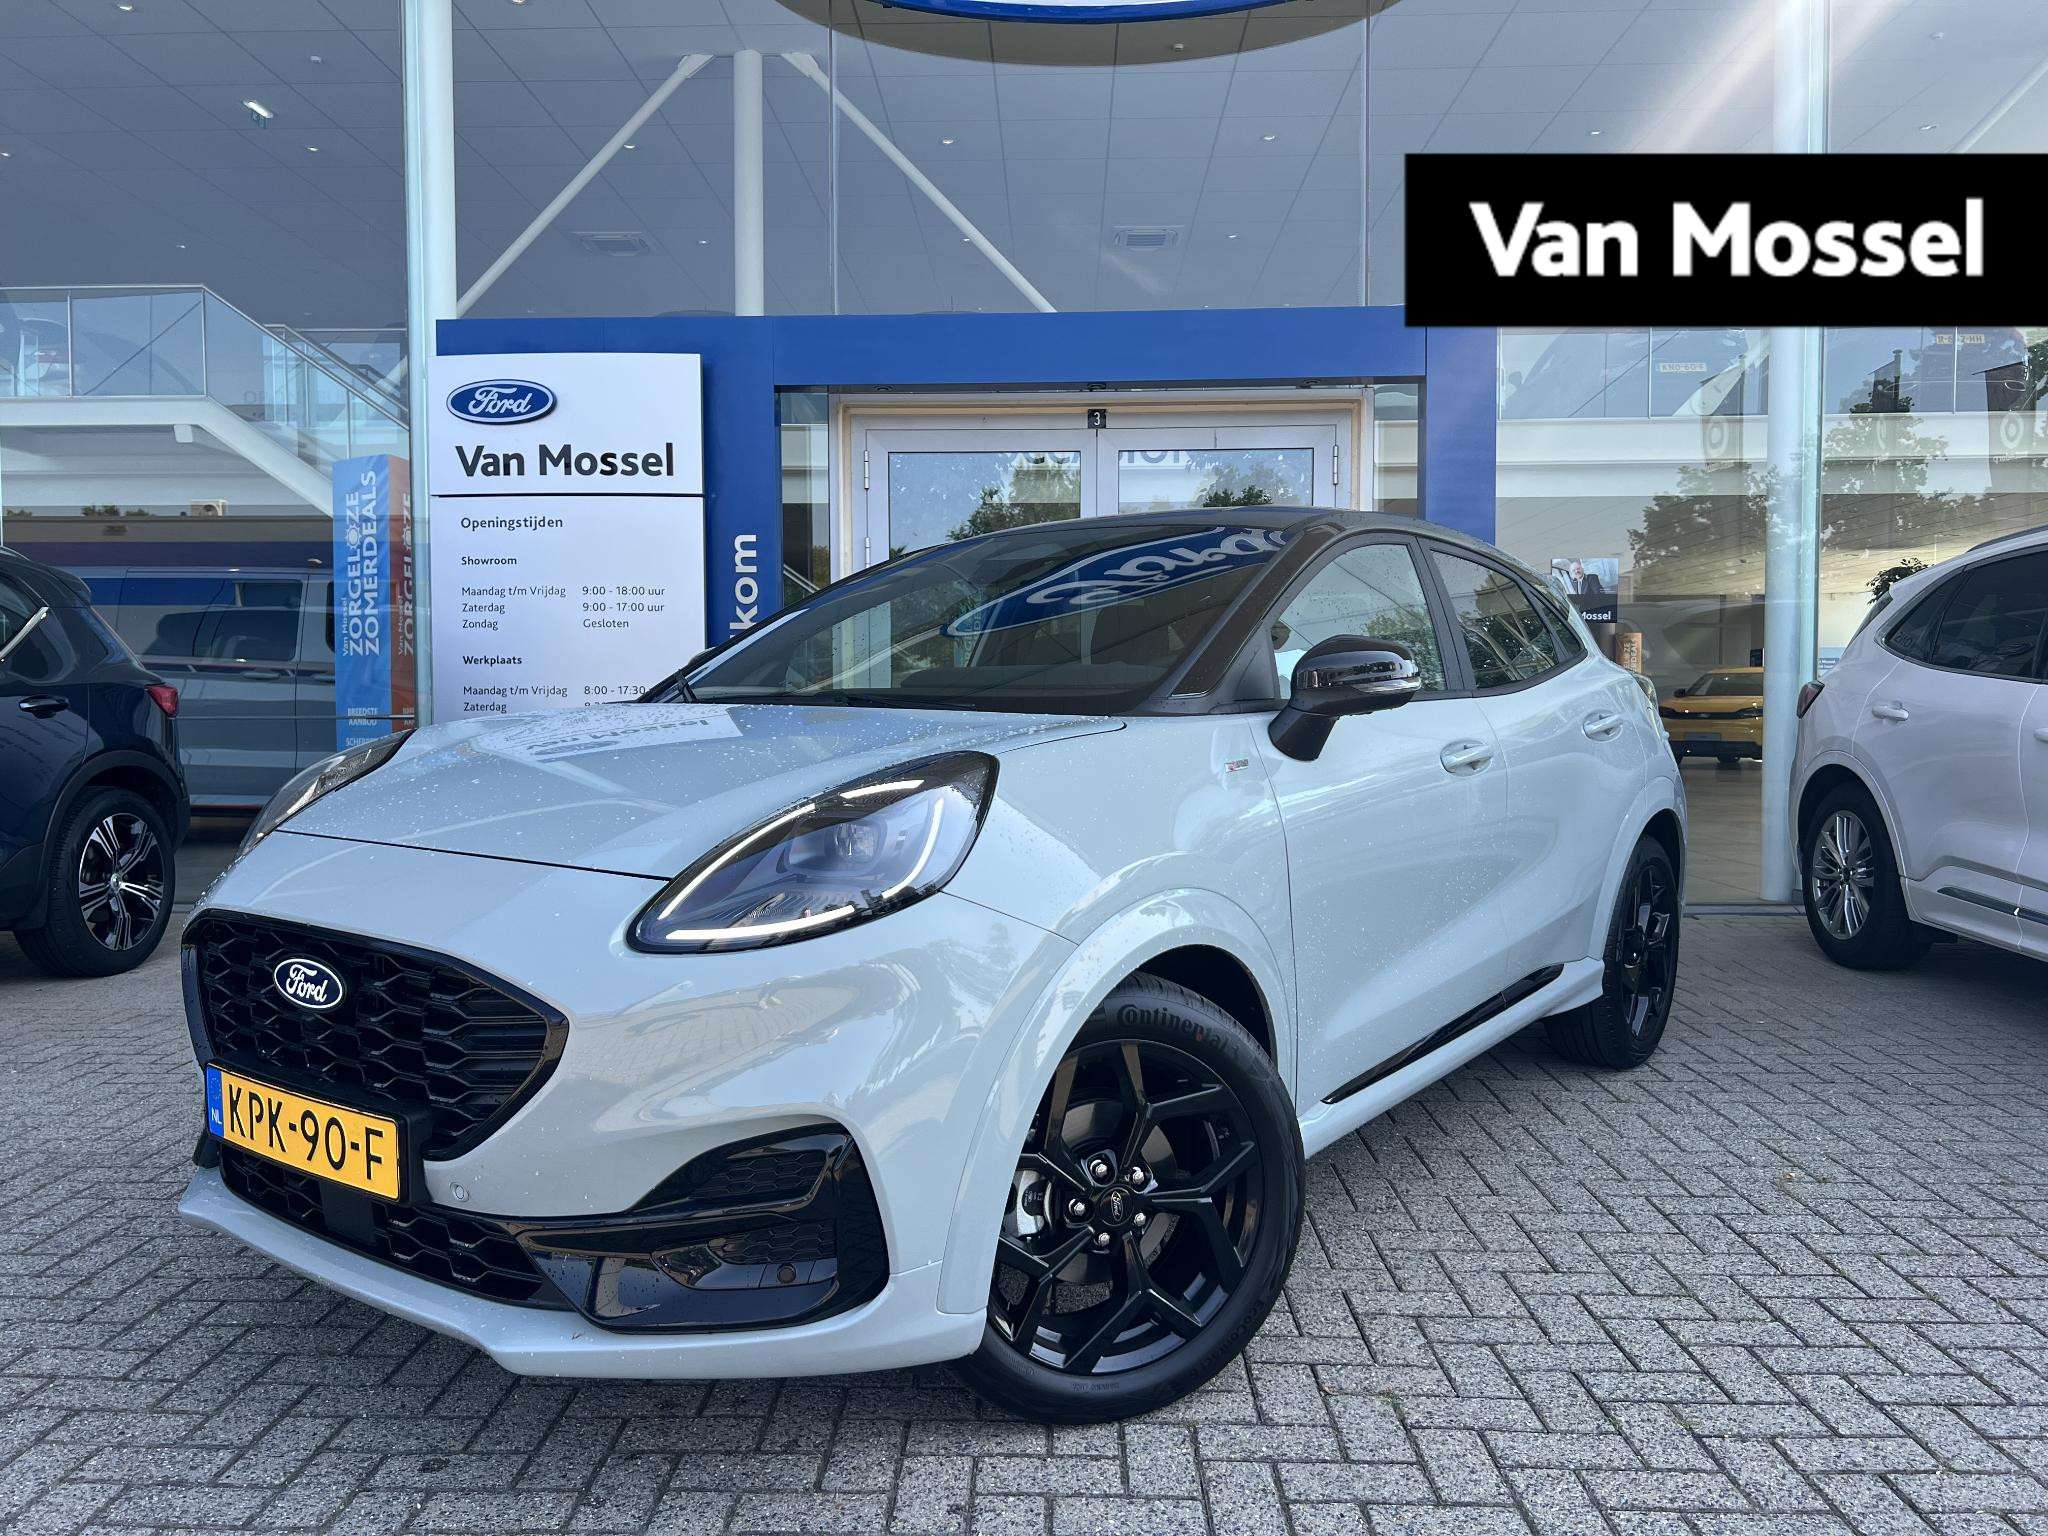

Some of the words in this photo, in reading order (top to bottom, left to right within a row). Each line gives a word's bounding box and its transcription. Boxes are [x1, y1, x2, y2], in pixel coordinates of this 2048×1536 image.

[468, 386, 532, 416] Ford
[1094, 411, 1101, 426] 3
[455, 444, 525, 477] Van
[538, 442, 674, 477] Mossel
[460, 516, 564, 532] Openingstijden
[360, 470, 380, 656] ZOMERDEALS
[461, 556, 518, 566] Showroom
[461, 586, 506, 598] Maandag
[508, 586, 527, 596] t/m
[530, 585, 567, 598] Vrijdag
[582, 586, 606, 596] 9:00
[616, 586, 646, 596] 18:00
[648, 588, 666, 596] uur
[729, 534, 759, 639] kom
[462, 602, 506, 615] Zaterdag
[582, 602, 606, 612] 9:00
[616, 602, 645, 612] 17:00
[647, 604, 665, 612] uur
[462, 618, 499, 631] Zondag
[583, 618, 629, 628] Gesloten
[462, 655, 523, 667] Werkplaats
[463, 686, 508, 698] Maandag
[510, 685, 529, 695] t/m
[531, 685, 568, 698] Vrijdag
[584, 685, 608, 695] 8:00
[618, 685, 646, 695] 17:30
[464, 702, 507, 714] Zaterdag
[285, 963, 329, 1003] Ford
[1117, 1003, 1229, 1051] Continental
[211, 1107, 223, 1125] NL
[228, 1083, 384, 1181] KPK-90-F
